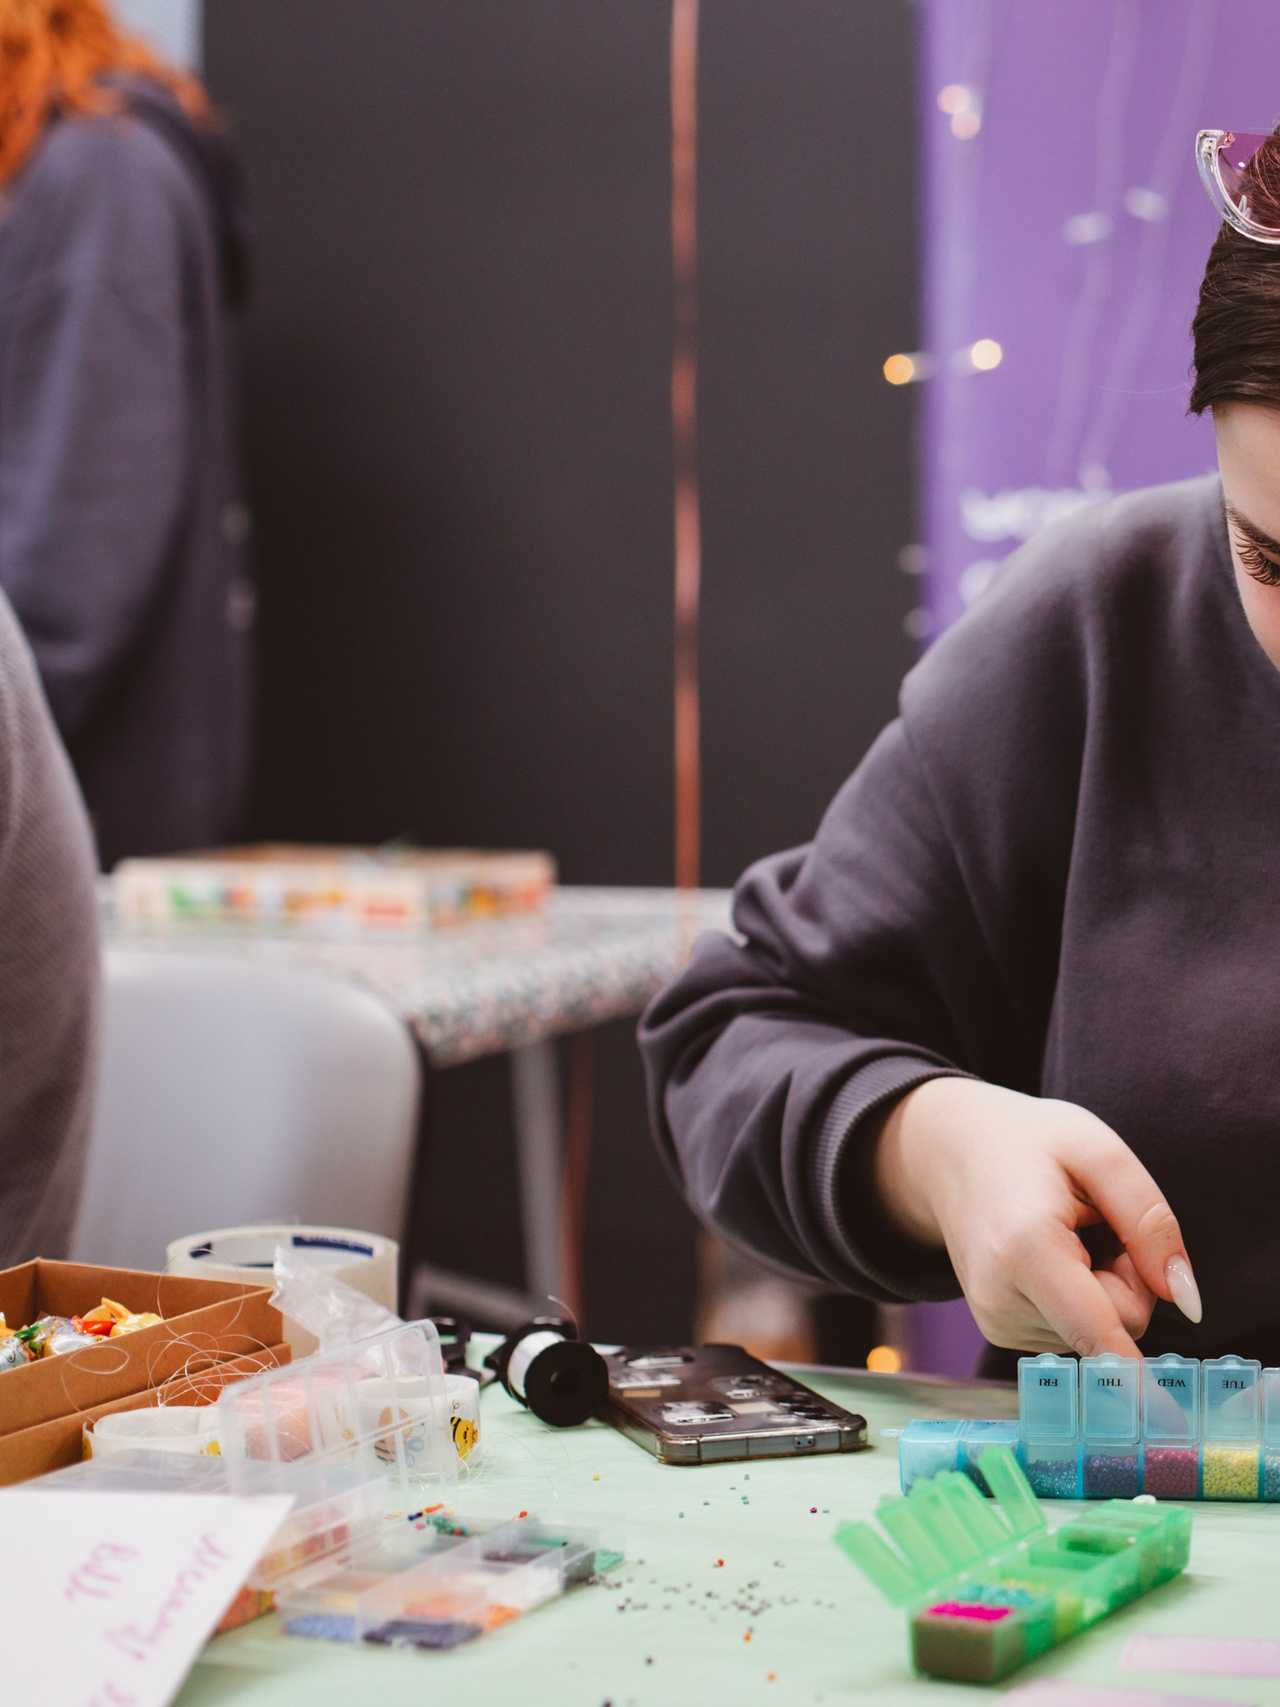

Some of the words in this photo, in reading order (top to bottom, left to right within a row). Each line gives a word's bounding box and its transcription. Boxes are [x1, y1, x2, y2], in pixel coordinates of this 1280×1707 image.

[1039, 1378, 1058, 1387] FRI
[1097, 1378, 1123, 1387] THU
[1157, 1378, 1186, 1387] WED
[1222, 1380, 1246, 1389] TUE
